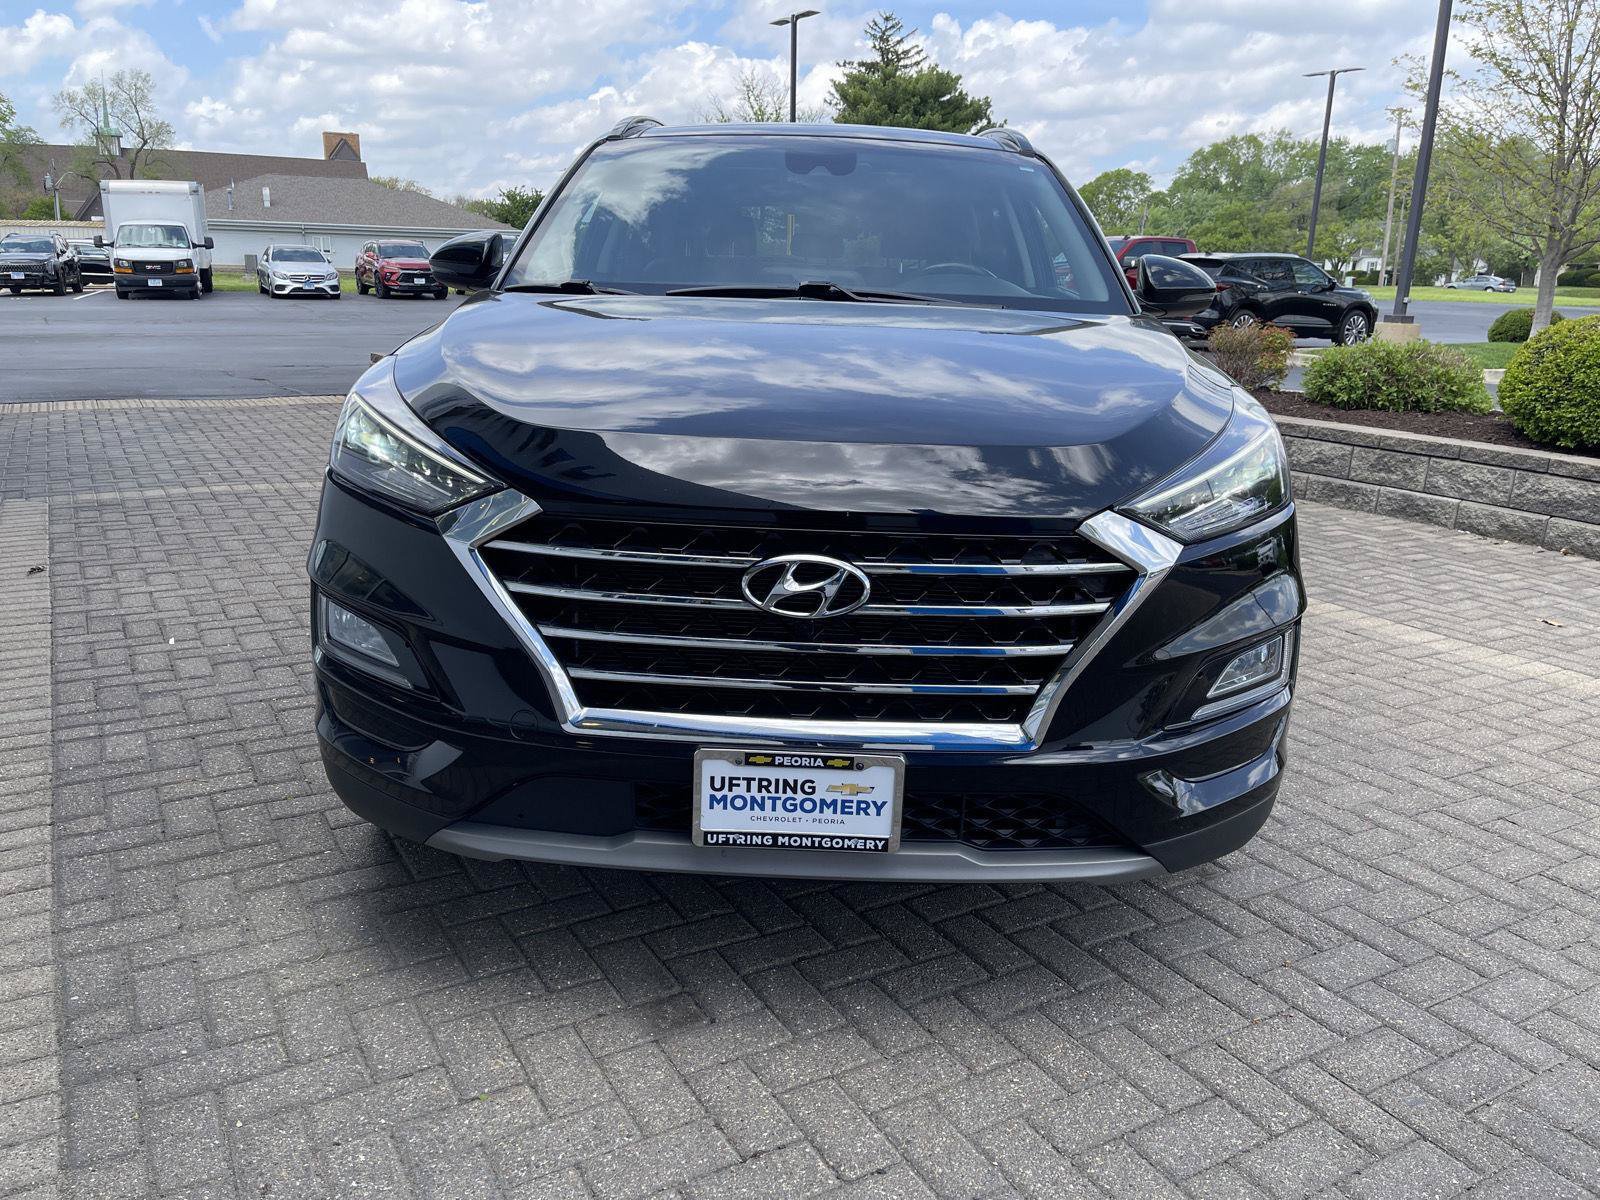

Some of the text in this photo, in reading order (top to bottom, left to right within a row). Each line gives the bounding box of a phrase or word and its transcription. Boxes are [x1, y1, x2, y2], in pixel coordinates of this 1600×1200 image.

[774, 756, 825, 767] PEORIA
[709, 776, 816, 796] UFTRING
[708, 794, 888, 817] MONTGOMERY
[750, 815, 802, 823] CHEVROLET
[707, 833, 886, 850] UFTRING MONTGOMERY
